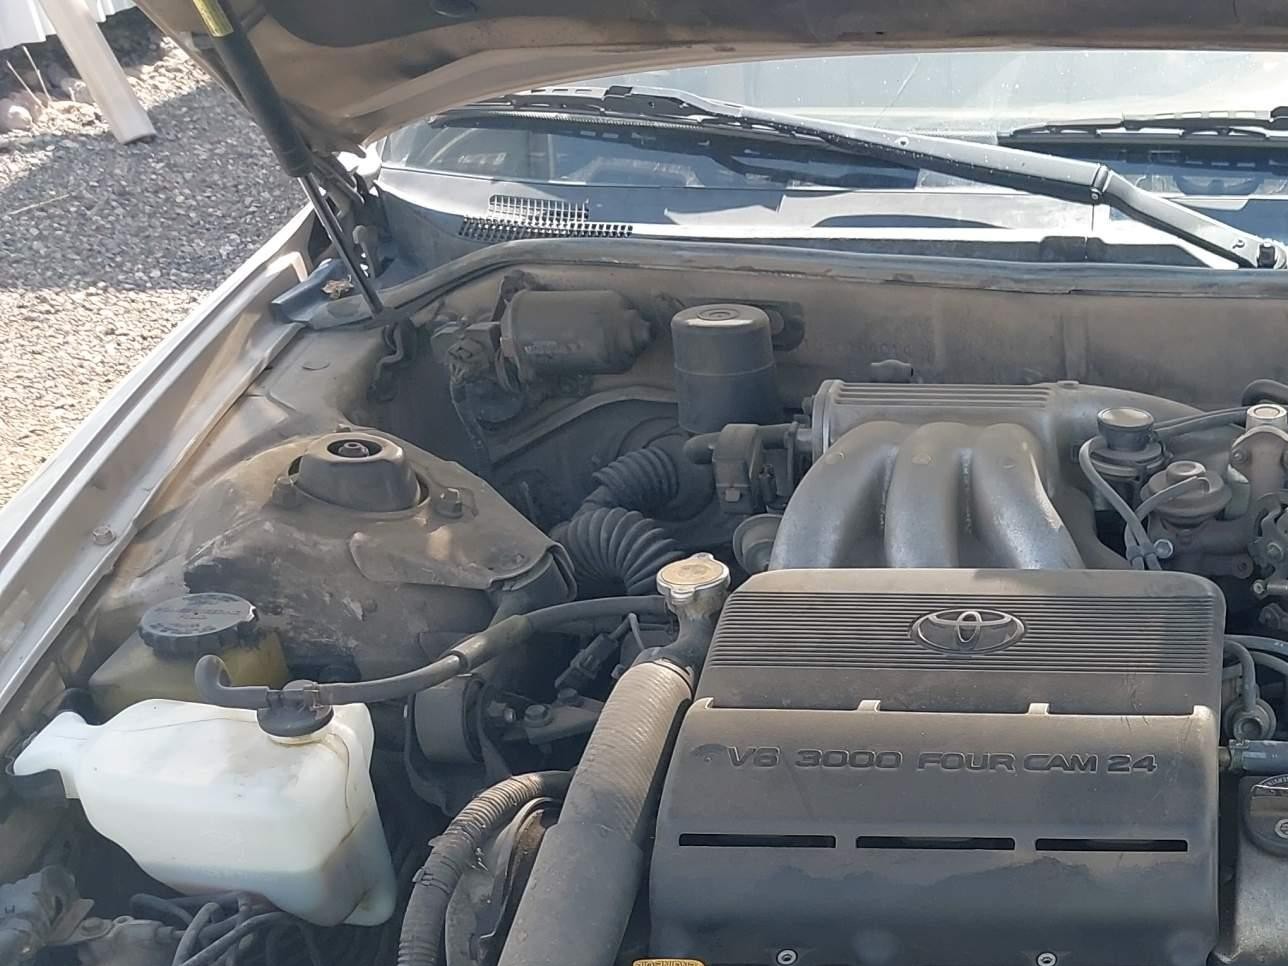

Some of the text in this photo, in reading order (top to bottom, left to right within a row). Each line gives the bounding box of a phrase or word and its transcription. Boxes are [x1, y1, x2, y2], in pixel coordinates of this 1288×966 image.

[727, 745, 1157, 775] V6 3000 FOUR CAM 24
